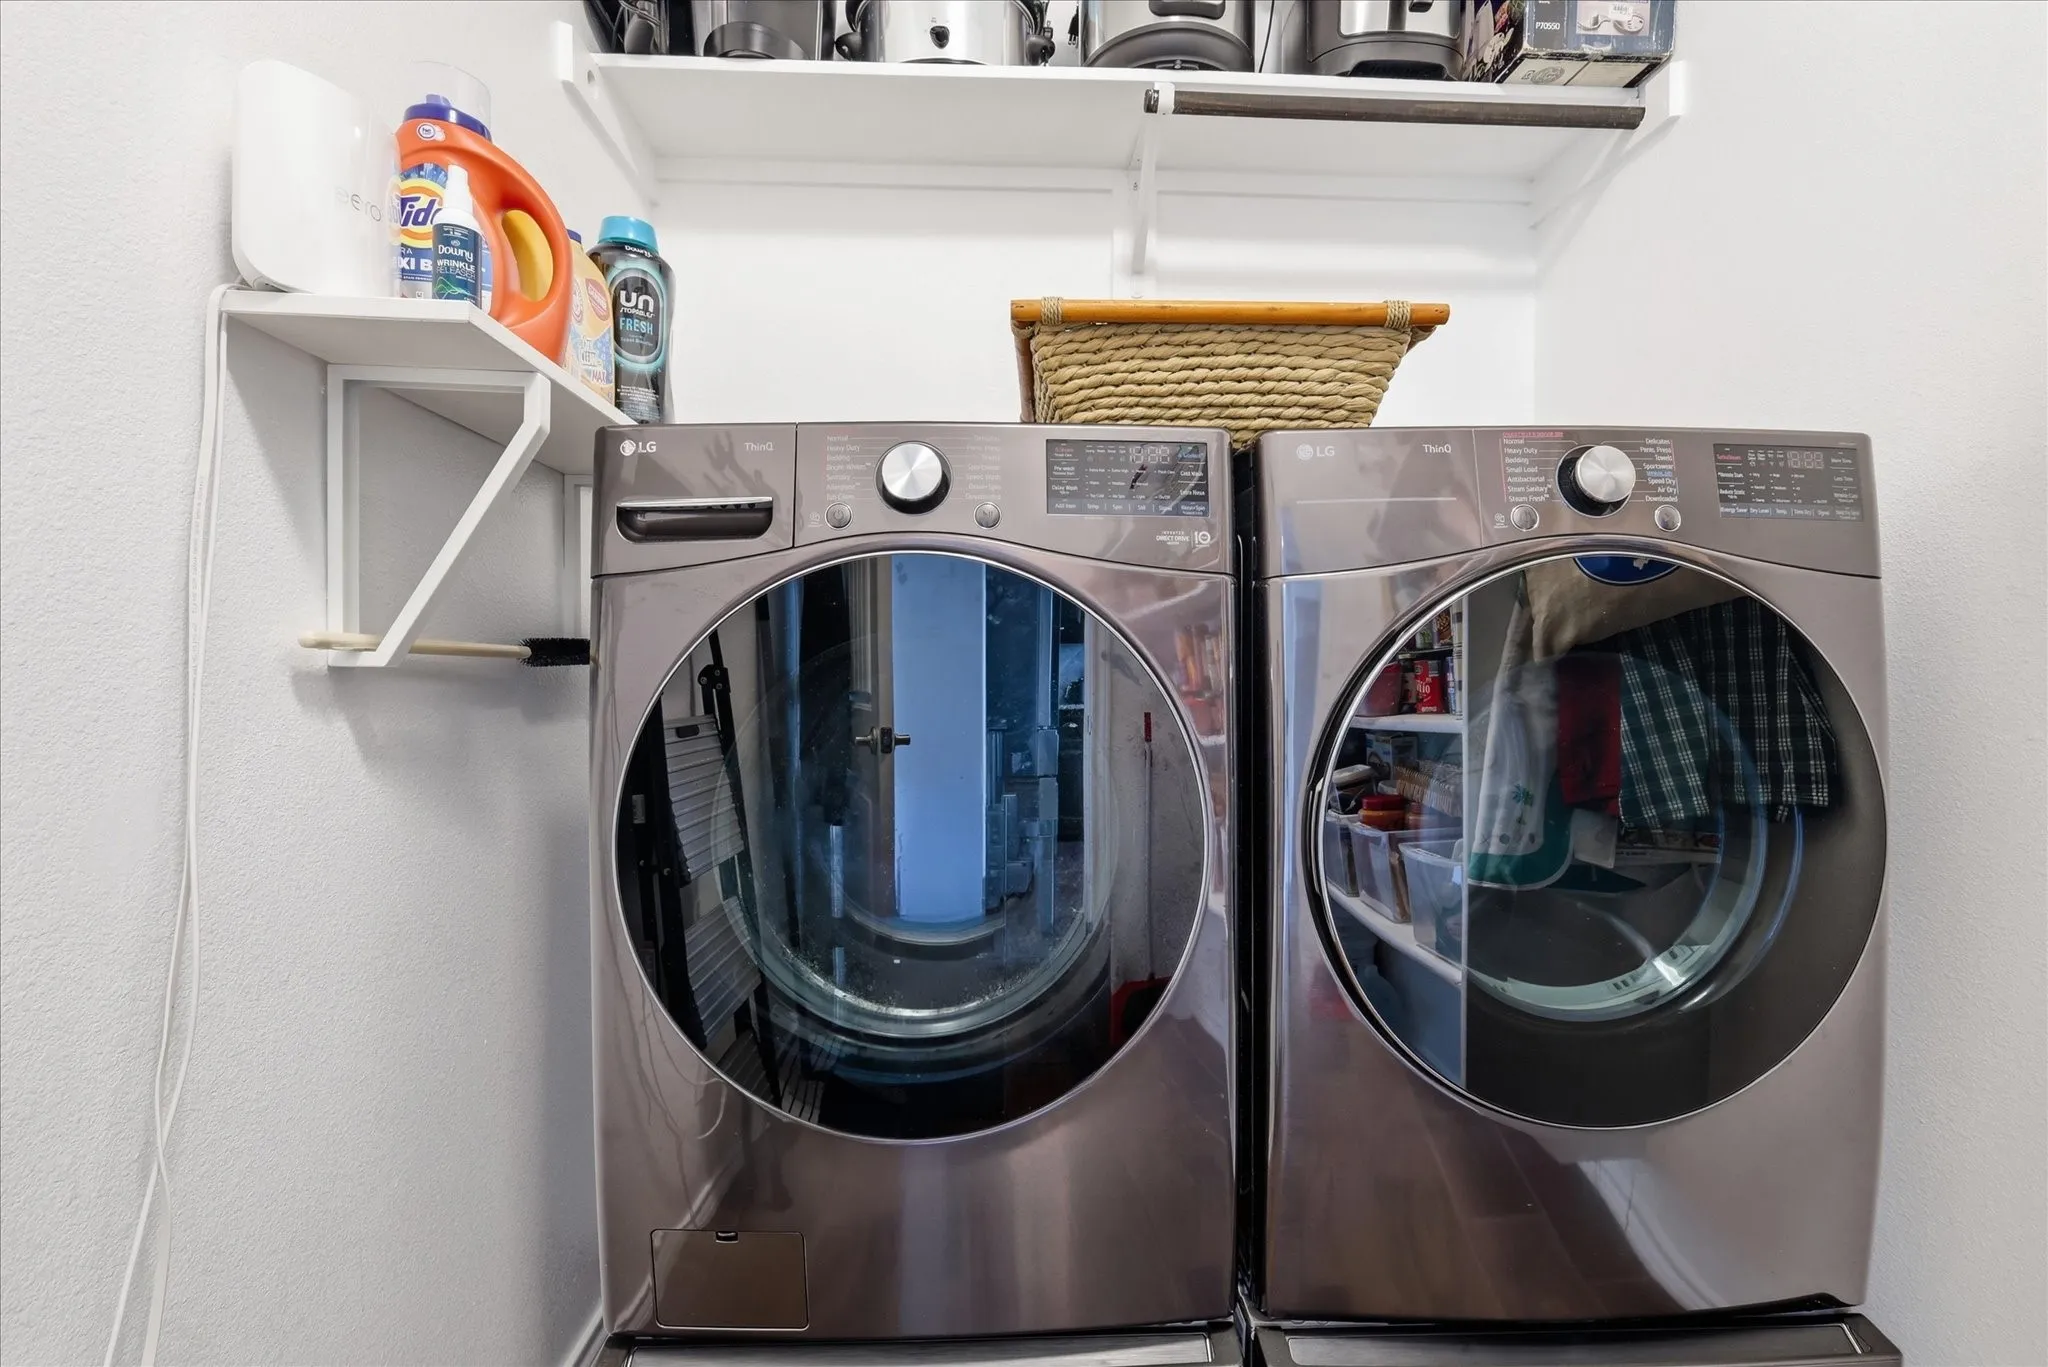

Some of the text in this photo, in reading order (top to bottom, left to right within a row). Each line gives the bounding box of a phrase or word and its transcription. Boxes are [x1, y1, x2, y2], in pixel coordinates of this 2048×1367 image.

[1535, 21, 1560, 30] P70550
[438, 245, 474, 262] Downy
[624, 245, 653, 258] Downy
[420, 258, 433, 271] B
[437, 259, 476, 273] WRINKLE
[620, 317, 654, 335] FRESH
[638, 441, 657, 453] LG
[744, 441, 773, 452] ThinQ
[1316, 445, 1335, 457] LG
[1422, 443, 1452, 454] ThinQ
[1504, 447, 1538, 455] Heavy Duty
[1505, 457, 1529, 465] Bedding
[1647, 477, 1665, 485] Speed
